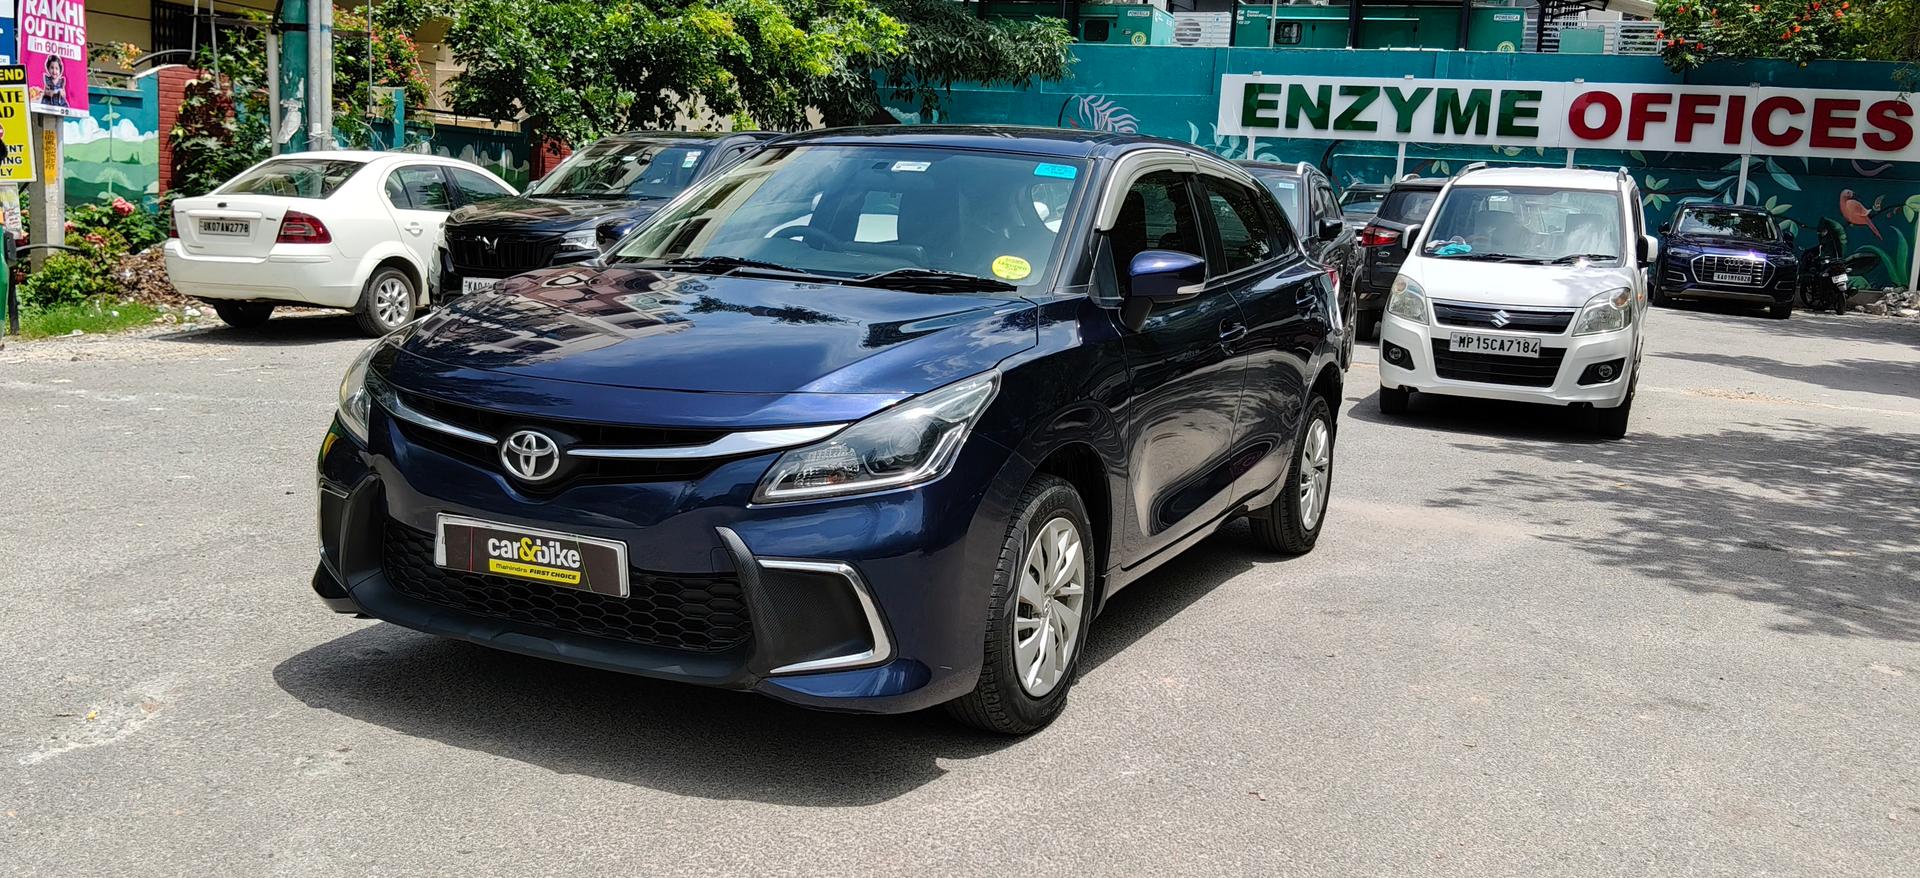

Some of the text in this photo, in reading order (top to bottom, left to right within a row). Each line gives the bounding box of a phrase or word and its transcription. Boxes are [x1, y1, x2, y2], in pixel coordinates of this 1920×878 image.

[25, 0, 84, 27] RAKHI
[25, 16, 85, 46] OUTFITS
[34, 42, 75, 57] in 60min
[1241, 82, 1914, 150] ENZYME OFFICES
[1458, 336, 1538, 354] MP15CA7184
[487, 537, 581, 568] car&bike
[529, 568, 550, 577] FIRST
[550, 571, 577, 581] CHOICE
